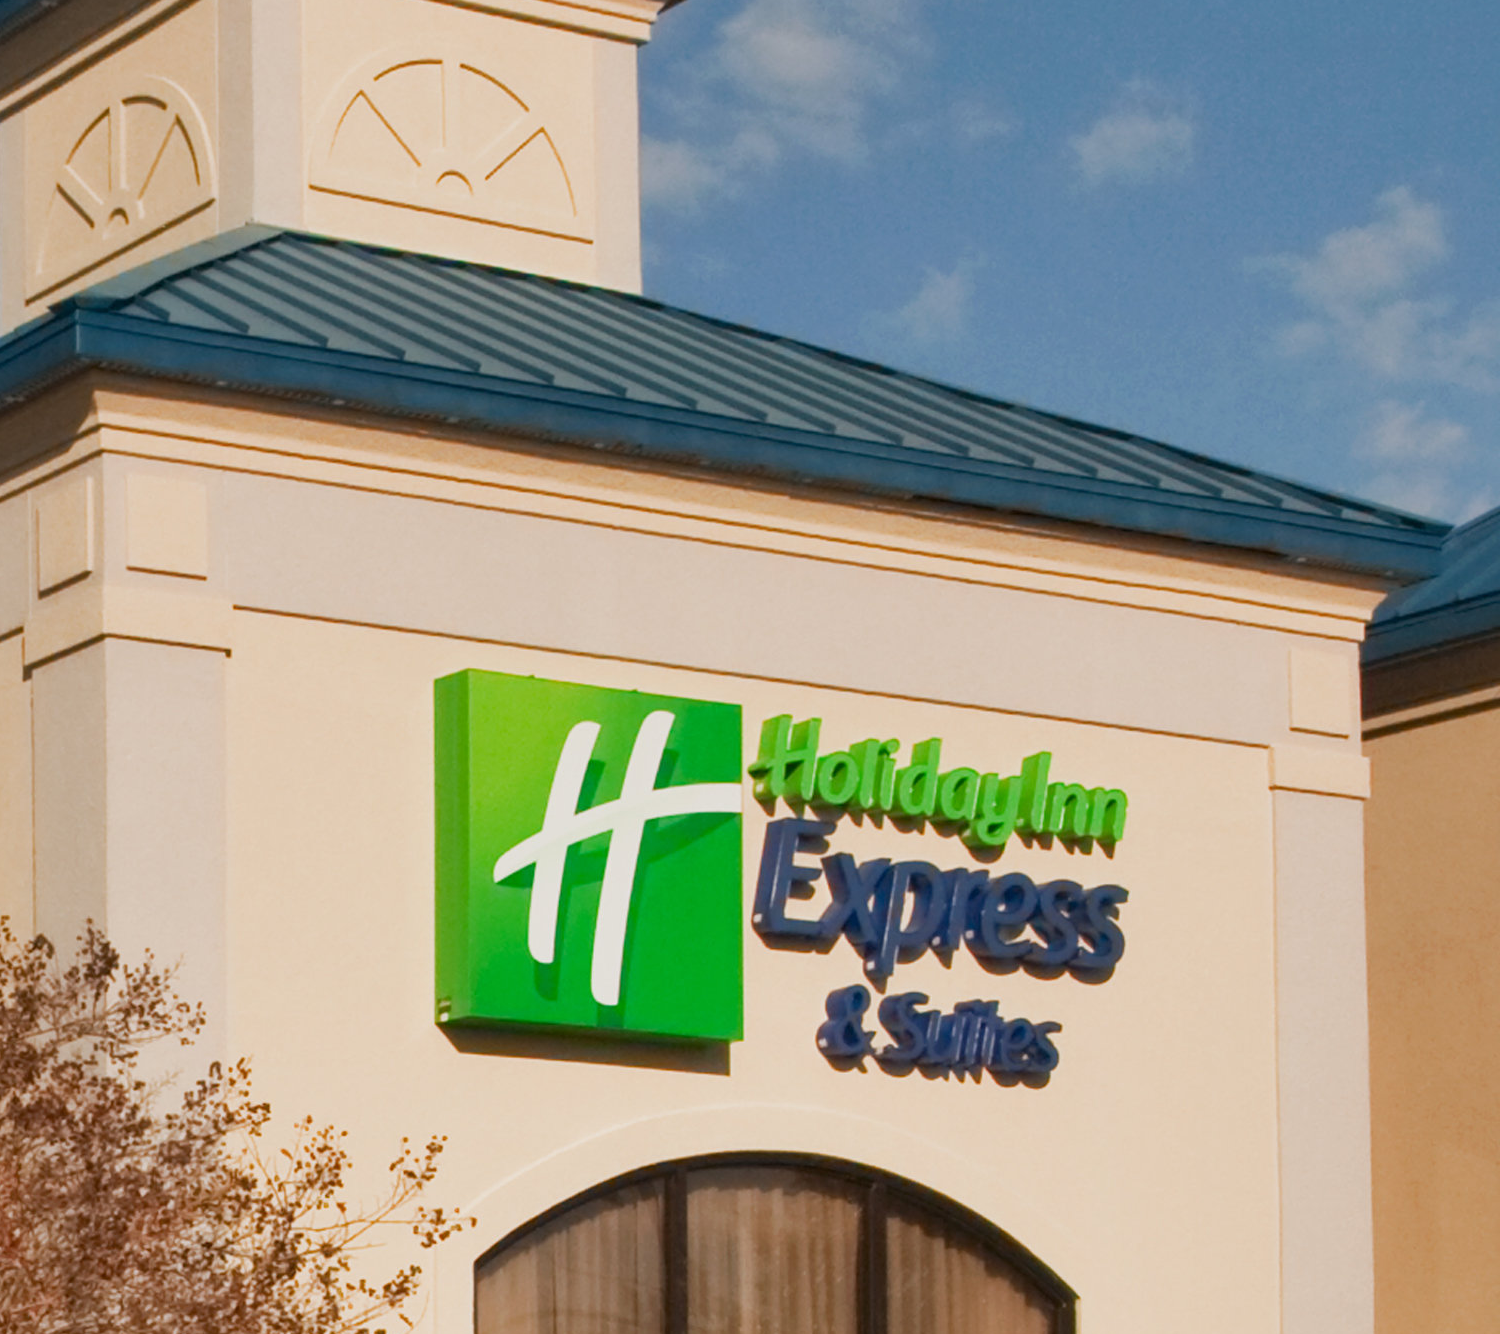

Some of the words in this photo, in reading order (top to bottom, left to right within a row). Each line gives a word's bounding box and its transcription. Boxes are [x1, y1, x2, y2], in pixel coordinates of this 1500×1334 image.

[749, 713, 1023, 847] Holiday
[1017, 750, 1128, 847] Inn
[752, 818, 1129, 985] Express
[817, 984, 874, 1073] &
[877, 990, 1061, 1086] Suites
